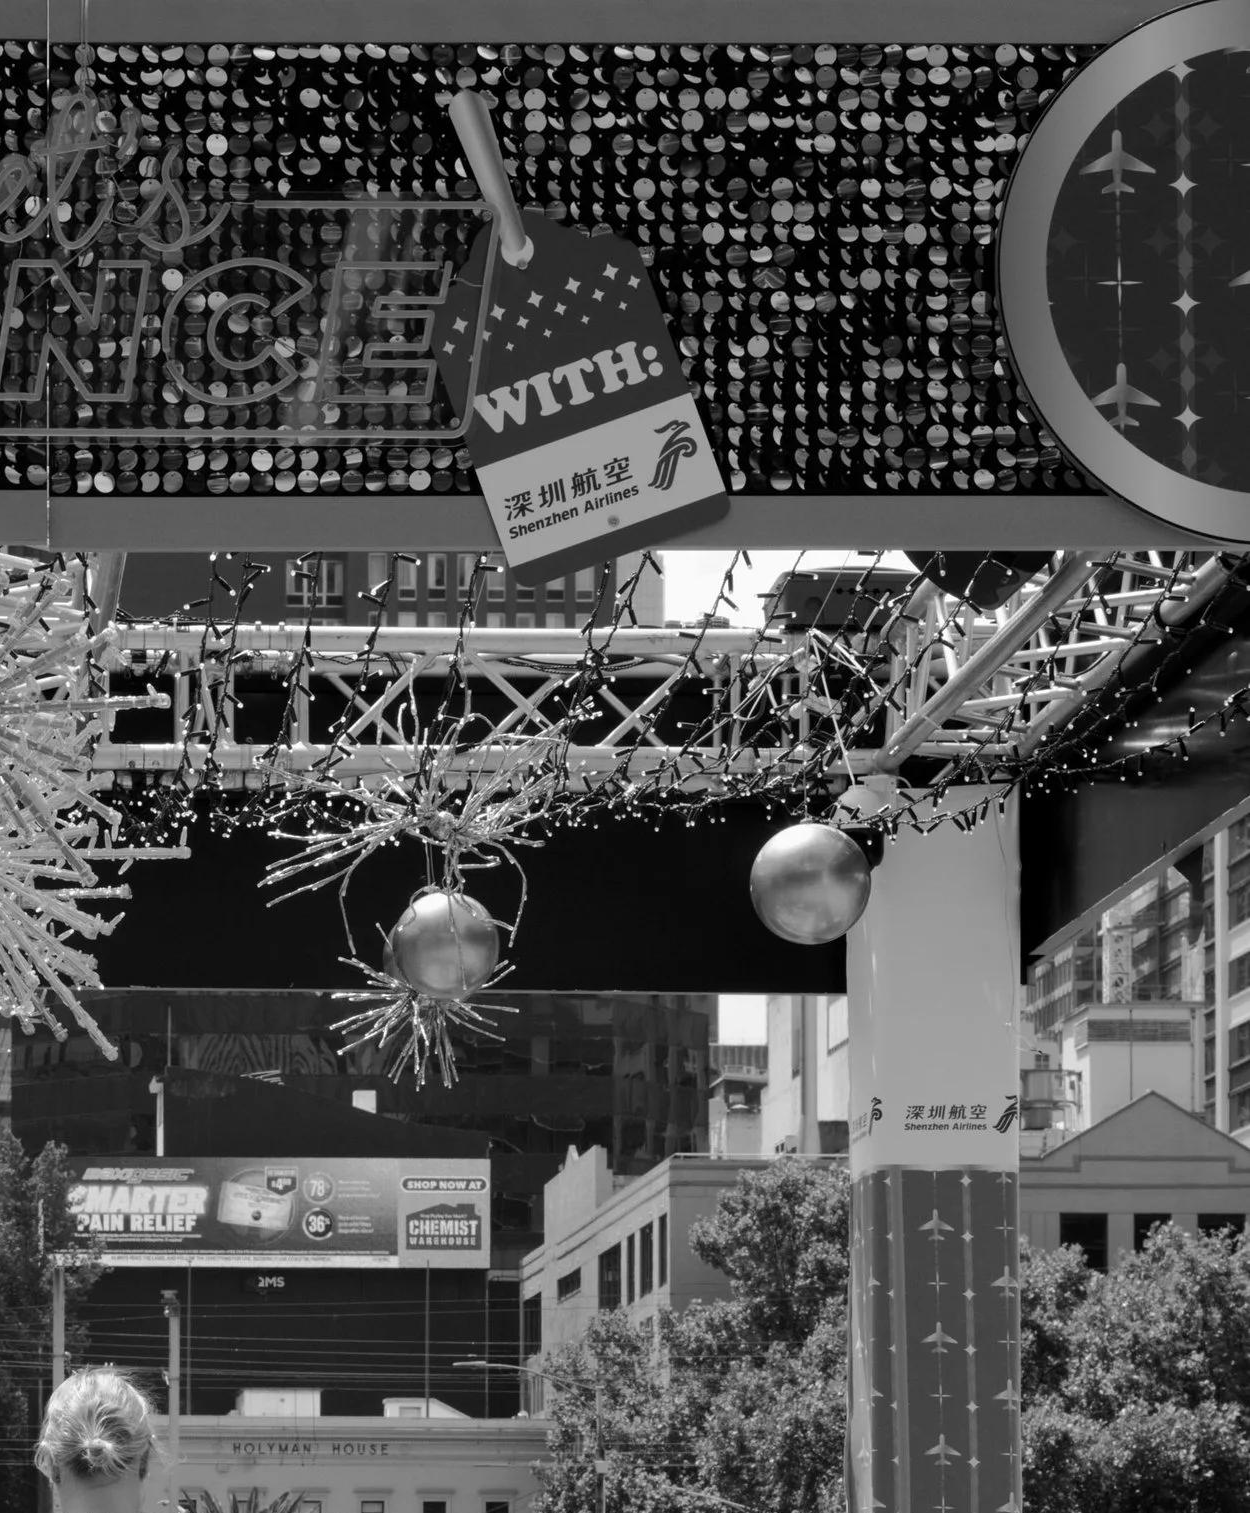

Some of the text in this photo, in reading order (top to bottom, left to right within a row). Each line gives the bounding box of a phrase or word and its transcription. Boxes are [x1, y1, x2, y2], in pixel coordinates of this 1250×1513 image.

[473, 341, 664, 433] WITH:
[504, 456, 633, 521] 深圳航空
[509, 485, 639, 539] Shenzhen Airlines
[906, 1104, 988, 1120] 深圳航空
[904, 1122, 987, 1131] Shenzhen Airlines
[407, 1181, 482, 1189] SHOP NOW AT
[66, 1185, 207, 1214] SMARTER
[77, 1214, 197, 1232] PAIN RELIEF
[409, 1220, 478, 1235] CHEMIST
[409, 1237, 476, 1245] WAREHOUSE
[232, 1442, 389, 1455] HOLYMAN HOUSE
